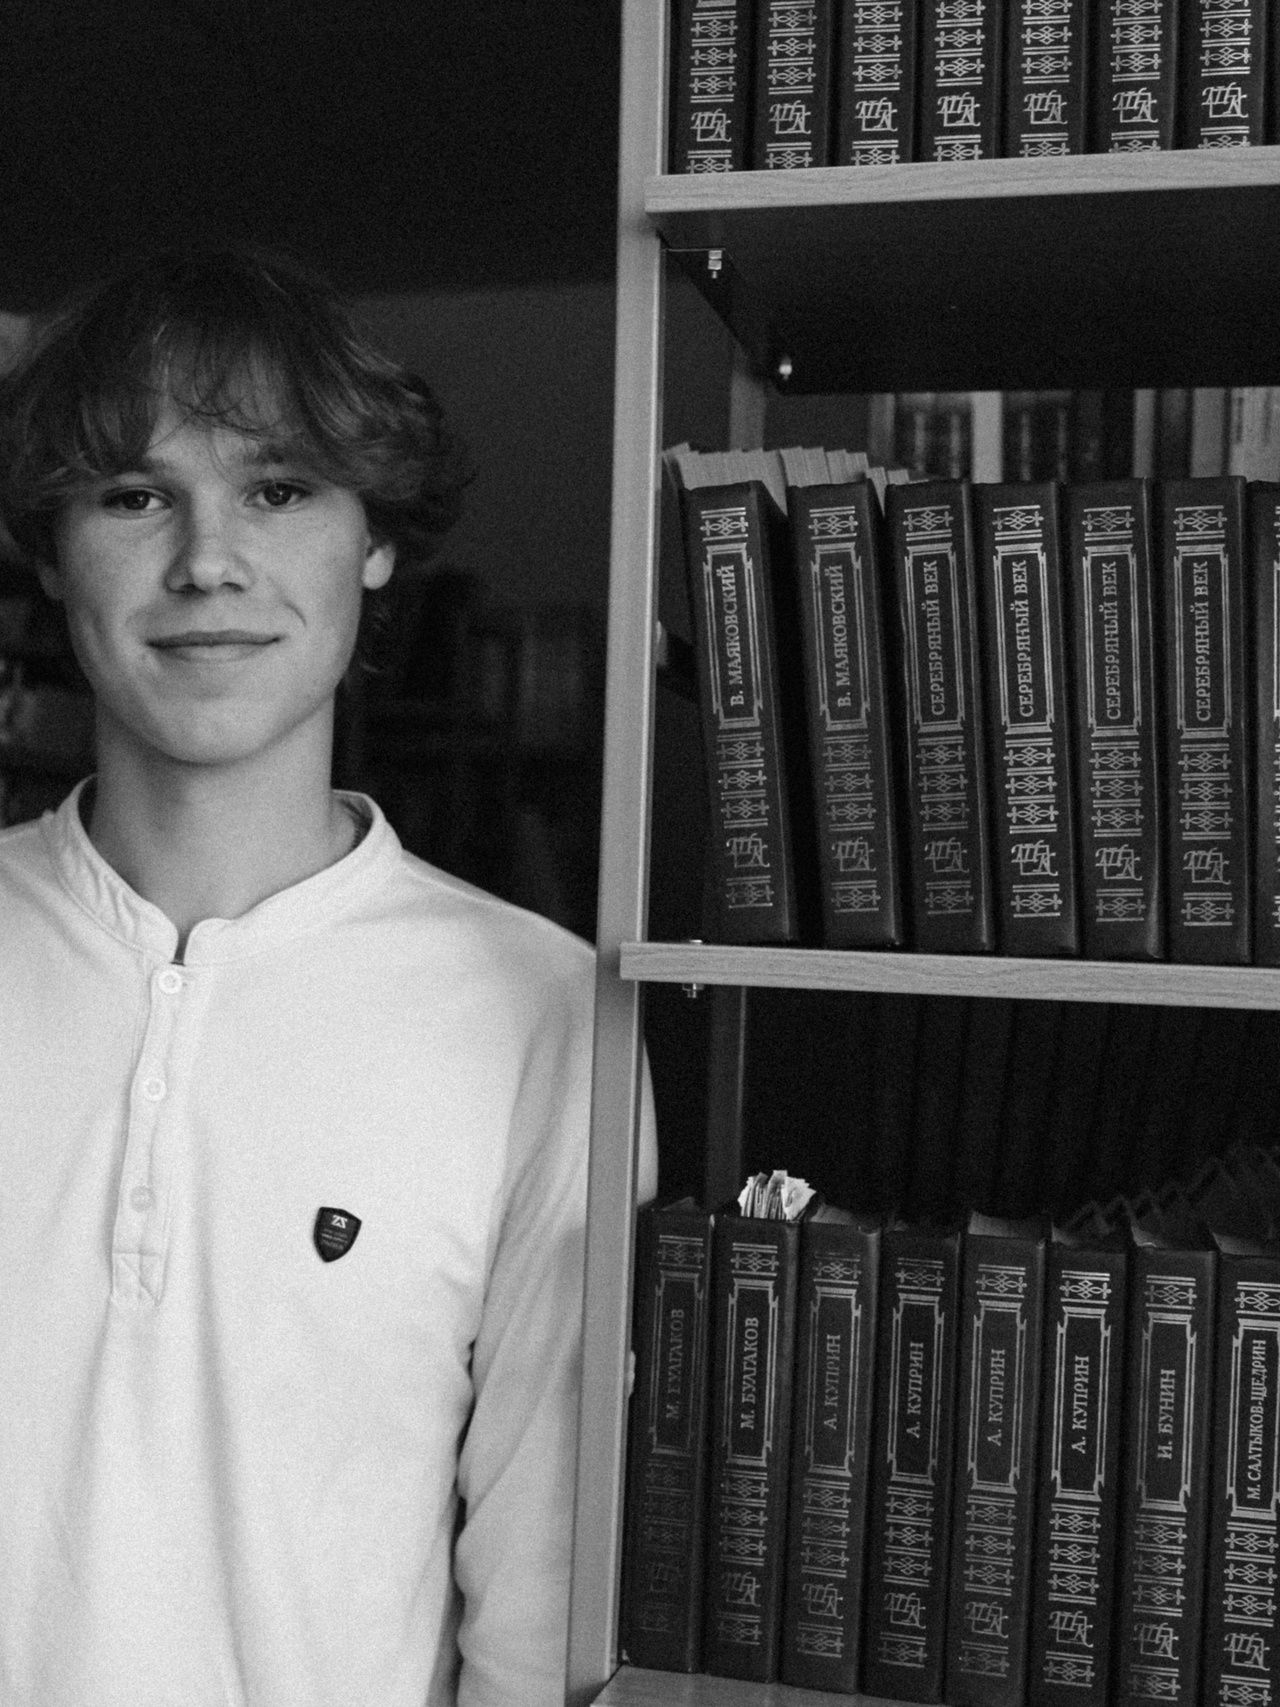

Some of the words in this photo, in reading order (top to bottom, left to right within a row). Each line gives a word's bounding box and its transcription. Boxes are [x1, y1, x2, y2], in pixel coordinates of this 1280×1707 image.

[923, 561, 938, 594] ВЕК
[1012, 560, 1027, 594] ВЕК
[1102, 562, 1117, 596] ВЕК
[1193, 562, 1208, 596] ВЕК
[718, 564, 743, 684] МАЯКОВСКИЙ
[825, 565, 850, 686] МАЯКОВСКИЙ
[921, 599, 945, 715] СЕРЕБРЯНЫЙ
[1010, 600, 1034, 717] СЕРЕБРЯНЫЙ
[1099, 601, 1121, 720] СЕРЕБРЯНЫЙ
[1190, 602, 1211, 721] СЕРЕБРЯНЫЙ
[730, 691, 744, 706] В.
[837, 692, 851, 707] В.
[742, 1317, 759, 1403] БУЛГАКОВ
[825, 1334, 841, 1406] КУПРИН
[907, 1342, 923, 1414] КУПРИН
[988, 1349, 1005, 1422] КУПРИН
[1072, 1356, 1089, 1429] КУПРИН
[1158, 1369, 1175, 1434] БУНИН
[740, 1410, 754, 1429] М.
[824, 1413, 838, 1431] А.
[906, 1420, 922, 1439] А.
[1247, 1340, 1267, 1481] САЛТЫКОВ-ЩЕДРИН
[987, 1429, 1002, 1446] А.
[1072, 1437, 1086, 1454] А.
[1158, 1441, 1172, 1459] И.
[1247, 1485, 1260, 1499] М.
